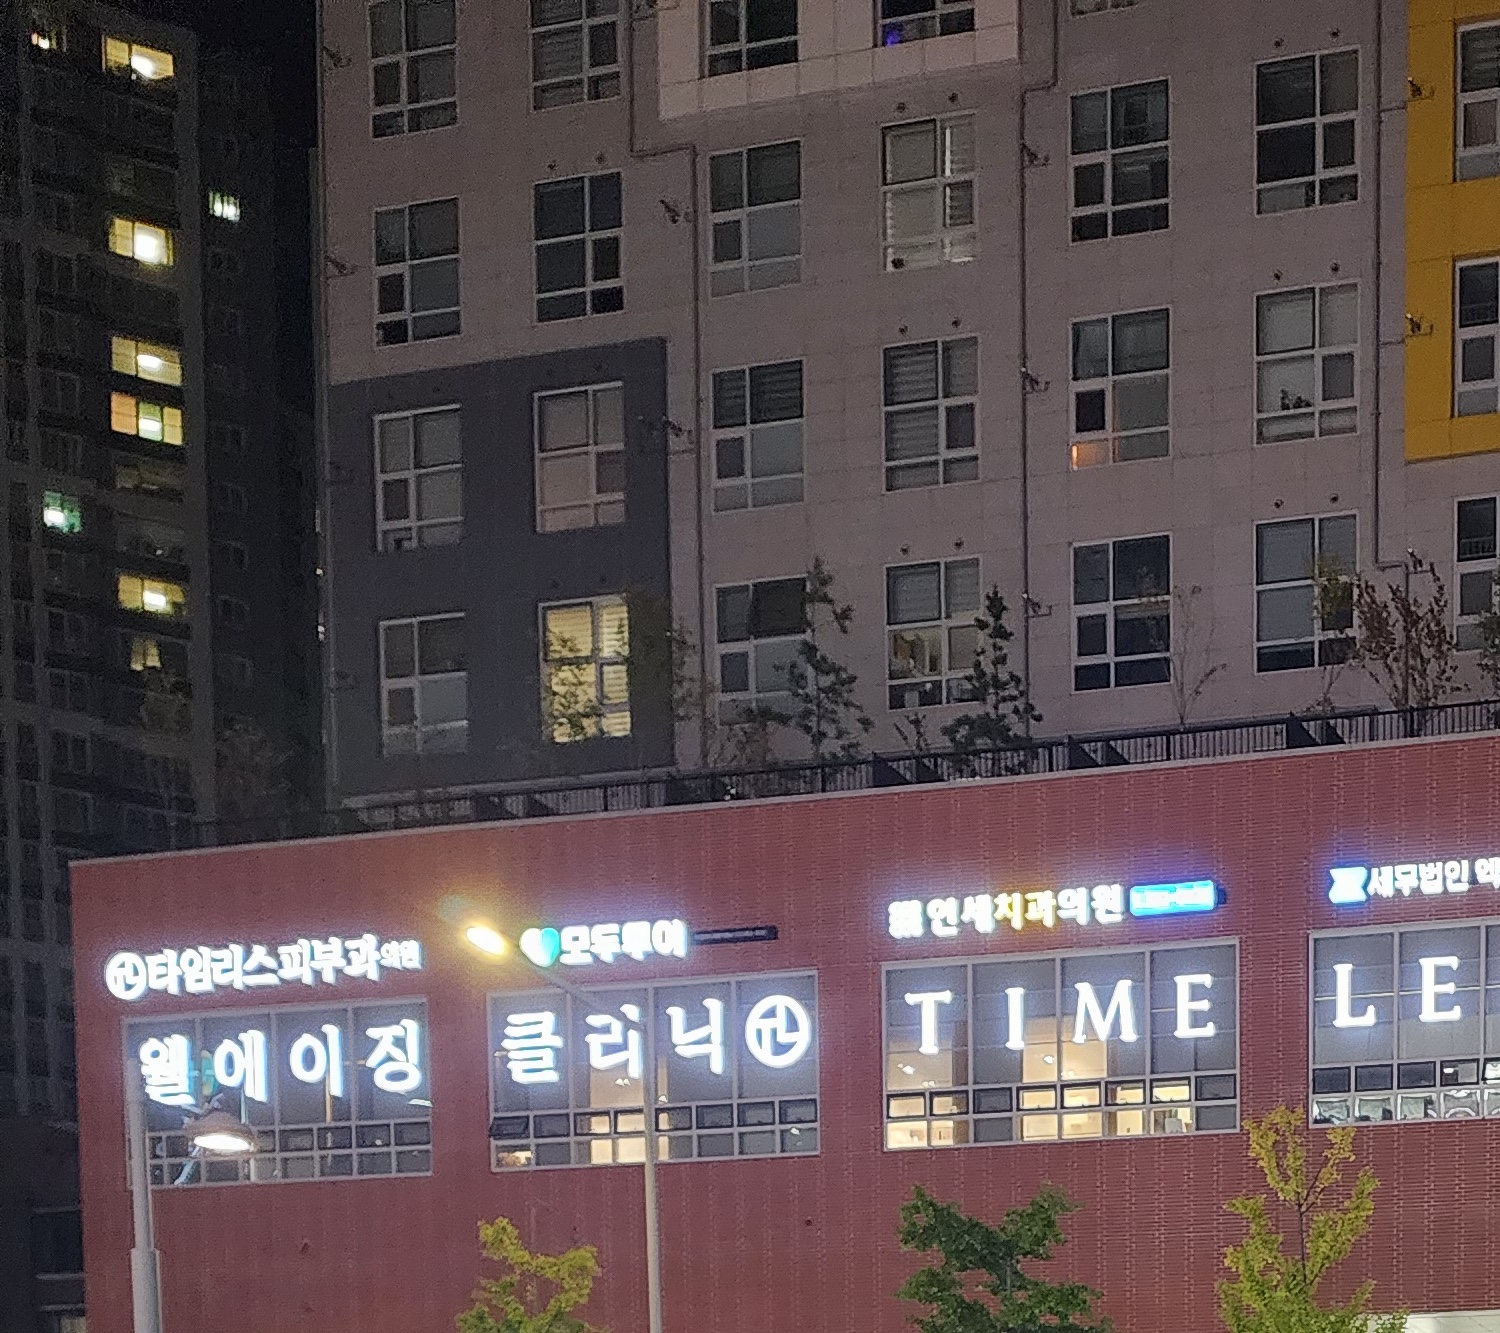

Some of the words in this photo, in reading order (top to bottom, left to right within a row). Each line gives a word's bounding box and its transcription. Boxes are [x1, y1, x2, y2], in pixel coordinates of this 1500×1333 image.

[926, 883, 1125, 938] 연세치과의원
[1368, 860, 1470, 897] 세무법인
[904, 972, 1218, 1055] TIME
[139, 1018, 422, 1106] 웰에이징
[501, 997, 724, 1085] 클리닉
